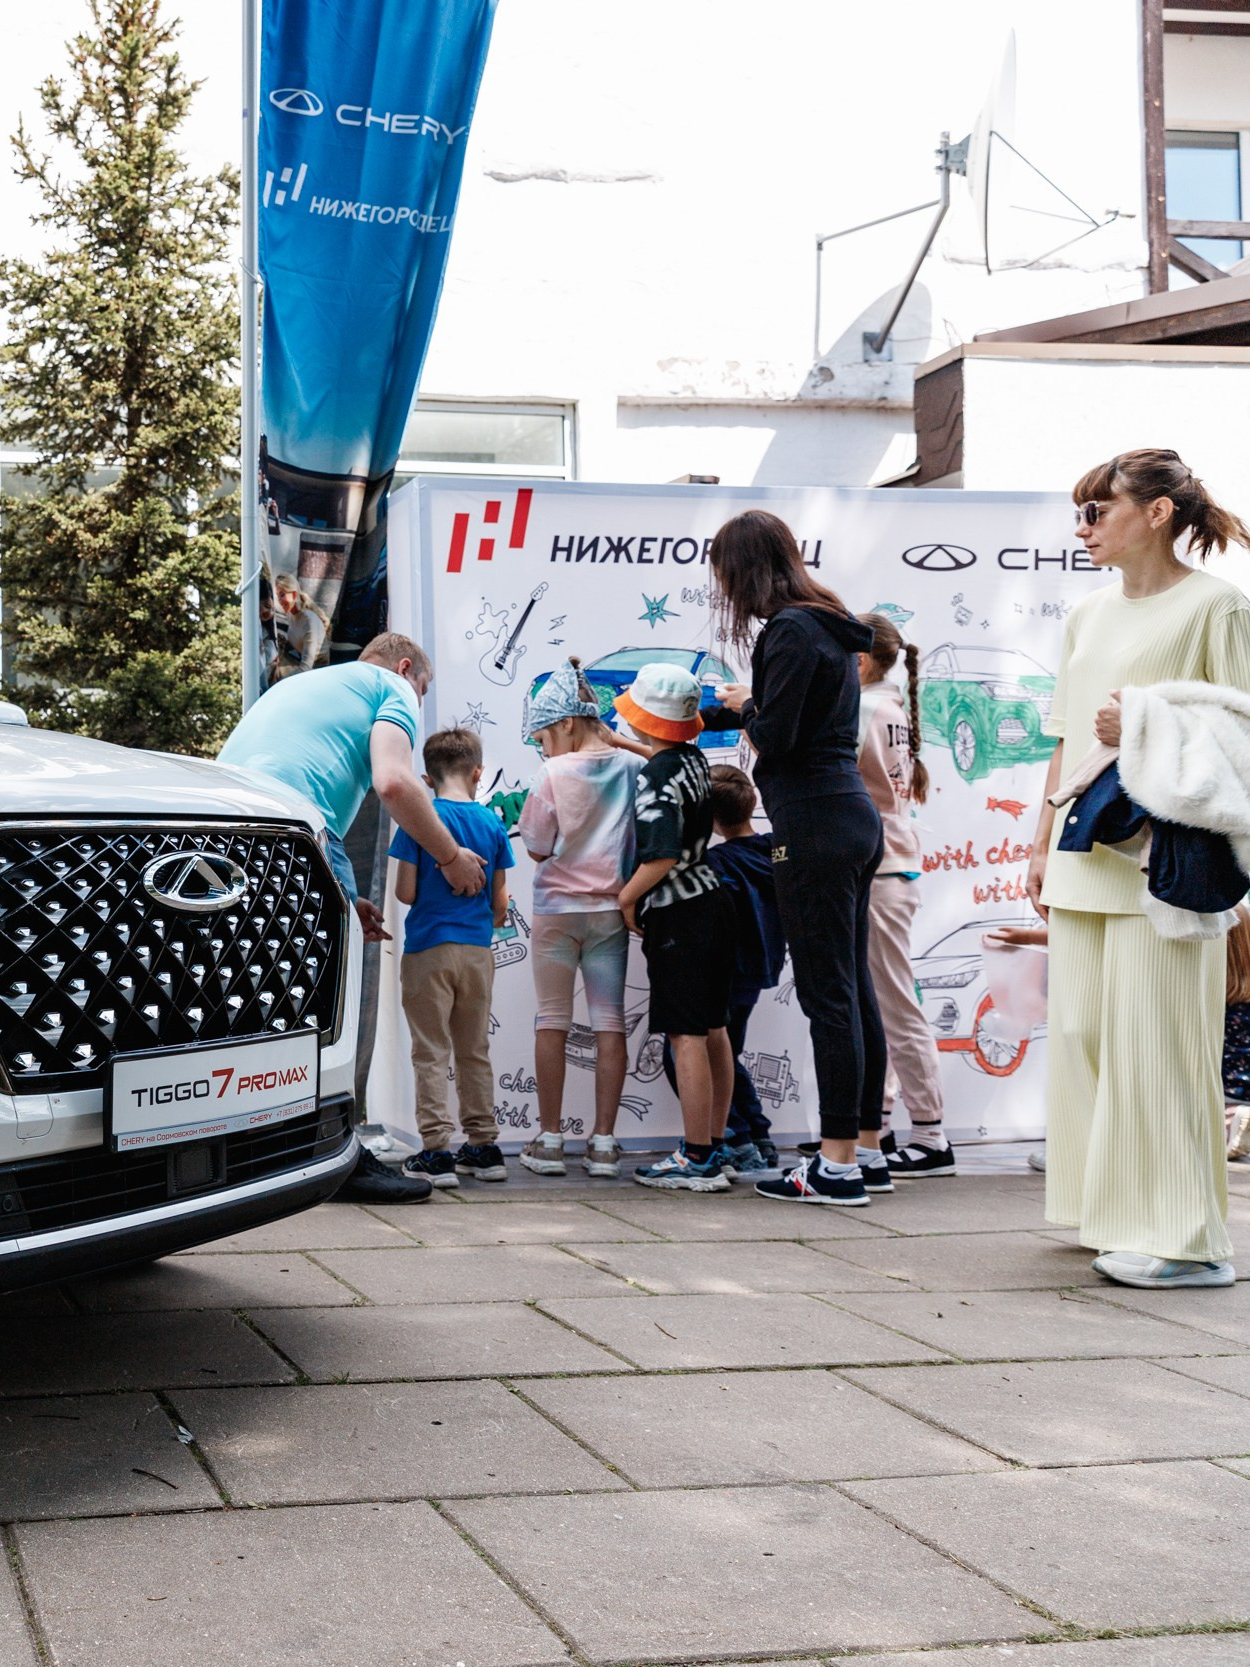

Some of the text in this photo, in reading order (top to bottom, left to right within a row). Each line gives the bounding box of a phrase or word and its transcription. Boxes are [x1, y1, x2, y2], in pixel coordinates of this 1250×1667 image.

[336, 104, 467, 145] CHERY
[998, 548, 1114, 571] CHE
[922, 840, 979, 872] with
[131, 1079, 210, 1107] TIGGO
[211, 1067, 235, 1099] 7
[250, 1112, 273, 1124] CHERY
[121, 1136, 145, 1147] CHERY
[156, 1130, 198, 1141] Сормовском
